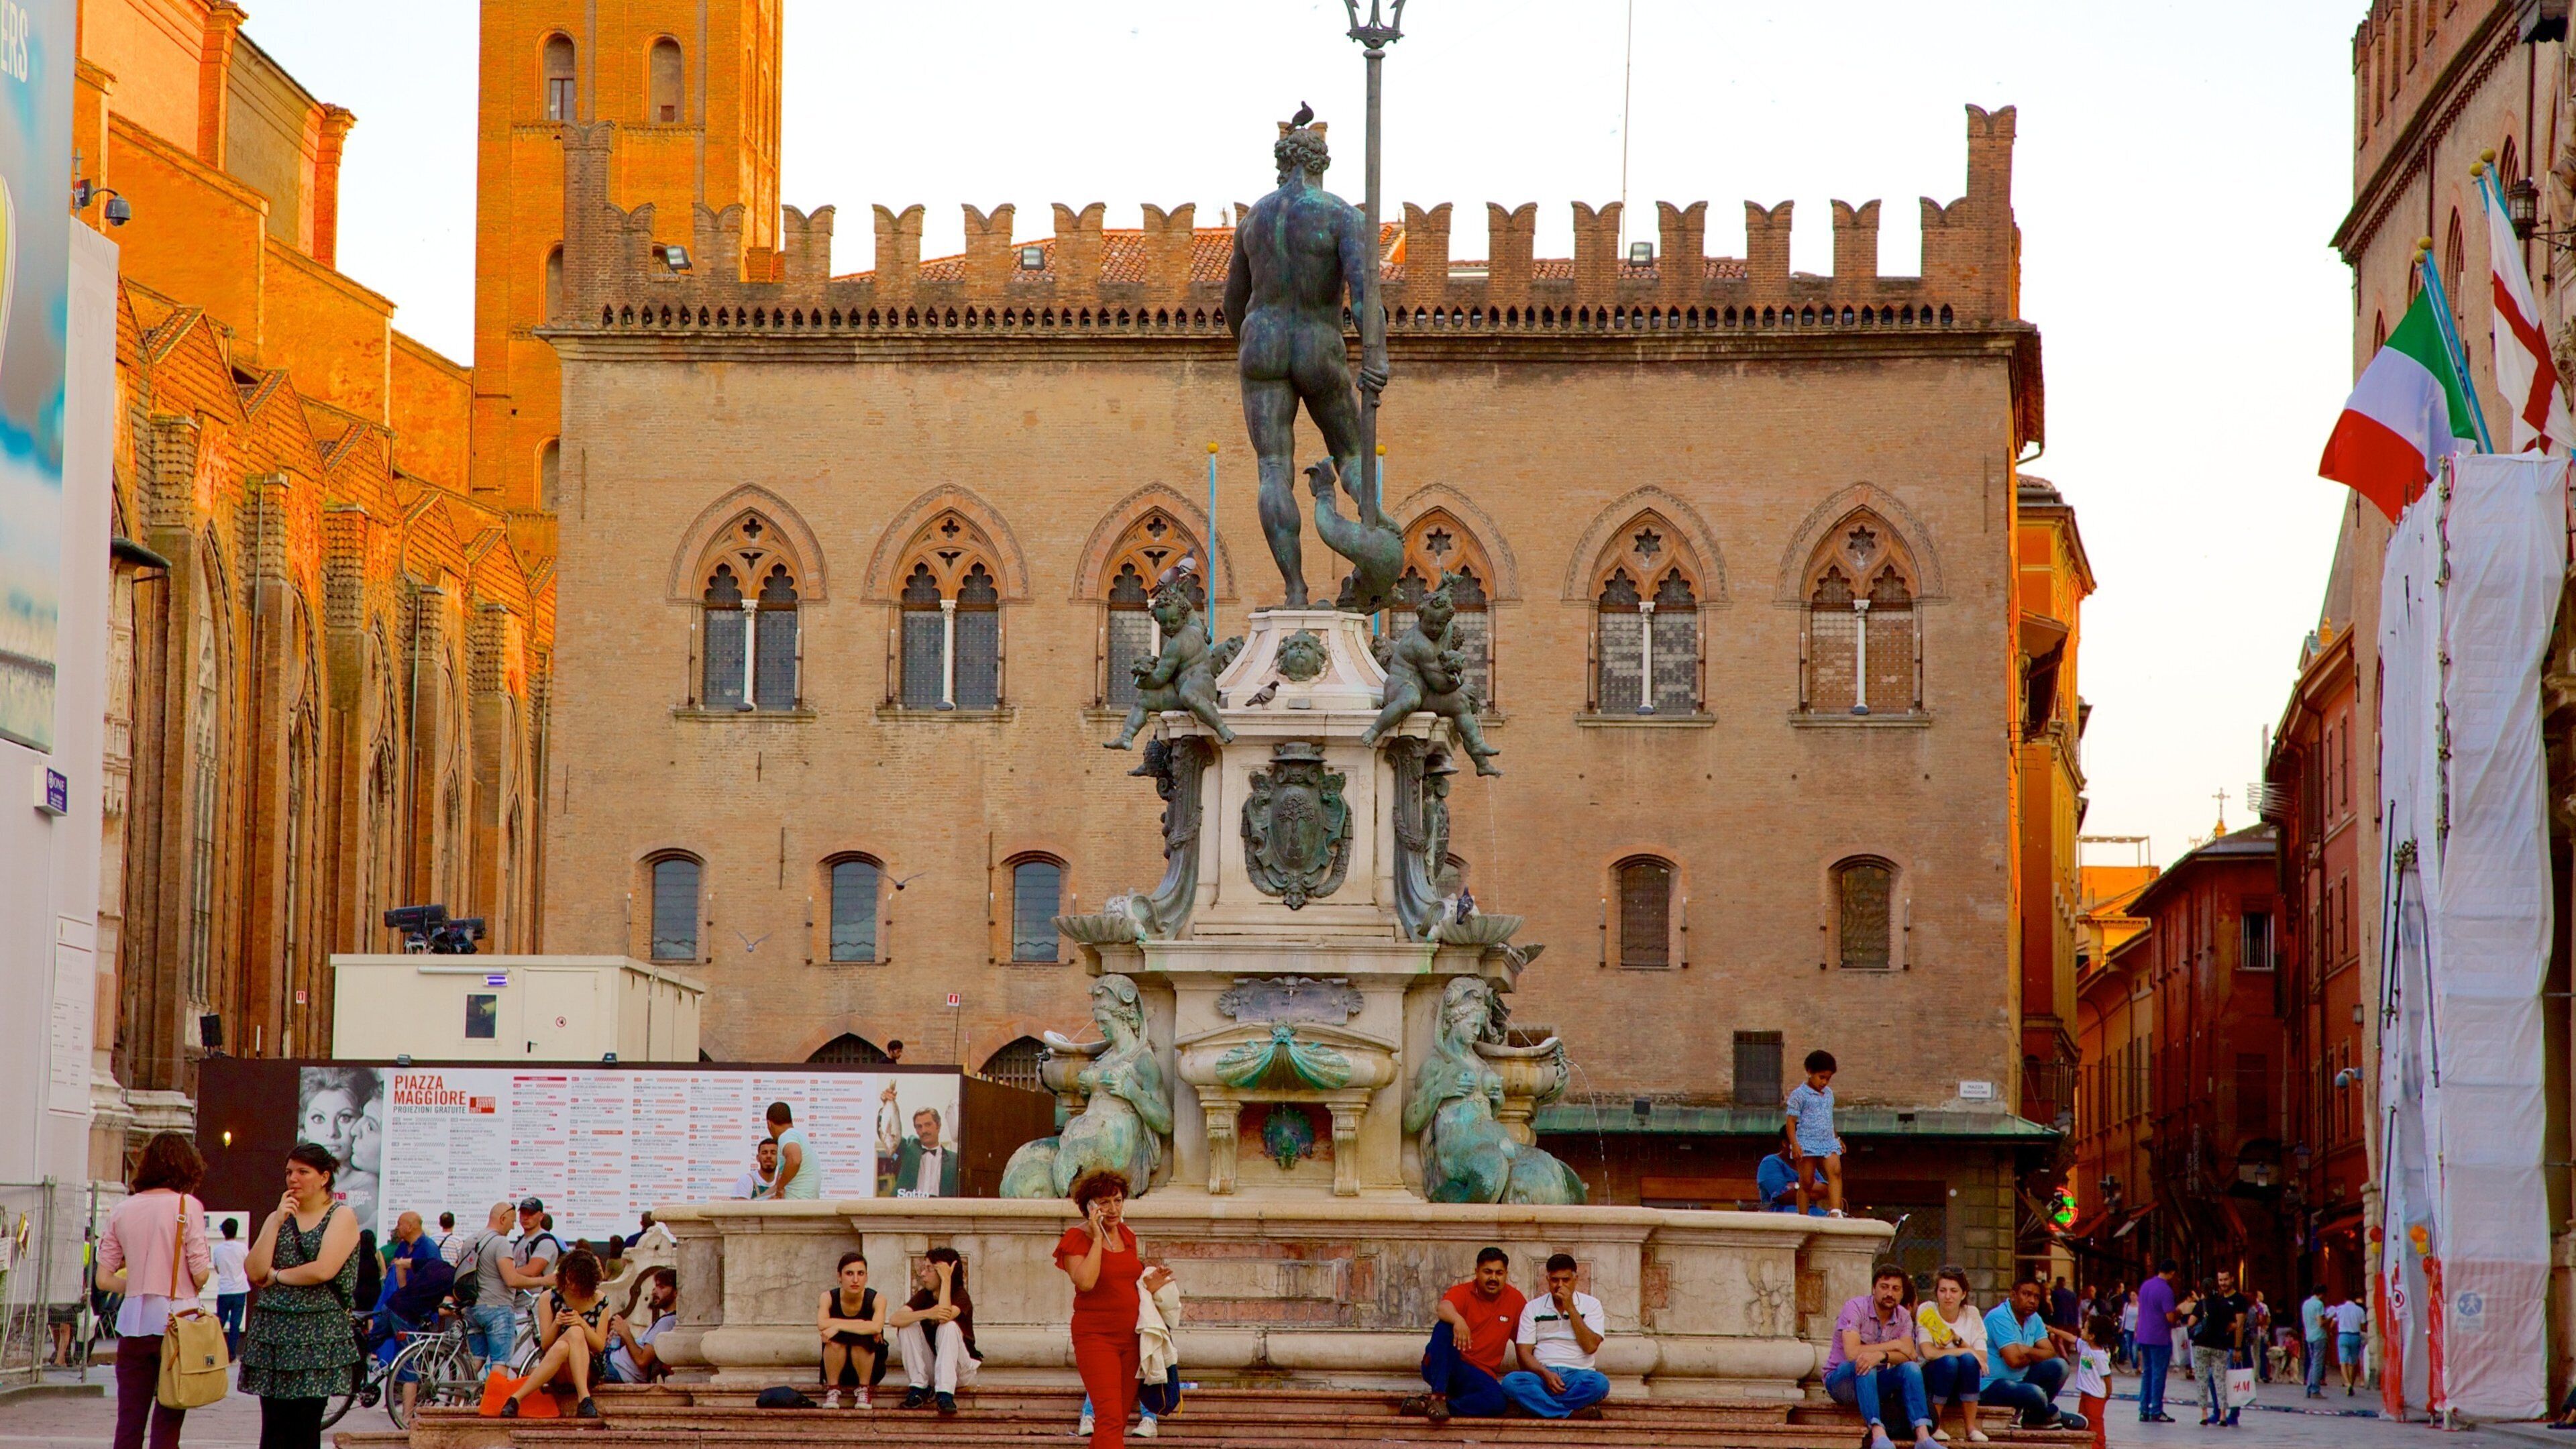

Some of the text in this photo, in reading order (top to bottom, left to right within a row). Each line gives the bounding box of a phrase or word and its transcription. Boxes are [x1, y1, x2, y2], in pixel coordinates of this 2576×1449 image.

[53, 777, 65, 792] ONE
[394, 1075, 444, 1090] PIAZZA
[393, 1090, 467, 1106] MAGGIORE
[392, 1106, 466, 1114] PROIEZIONI GRATUITE
[897, 1188, 930, 1199] Sotto
